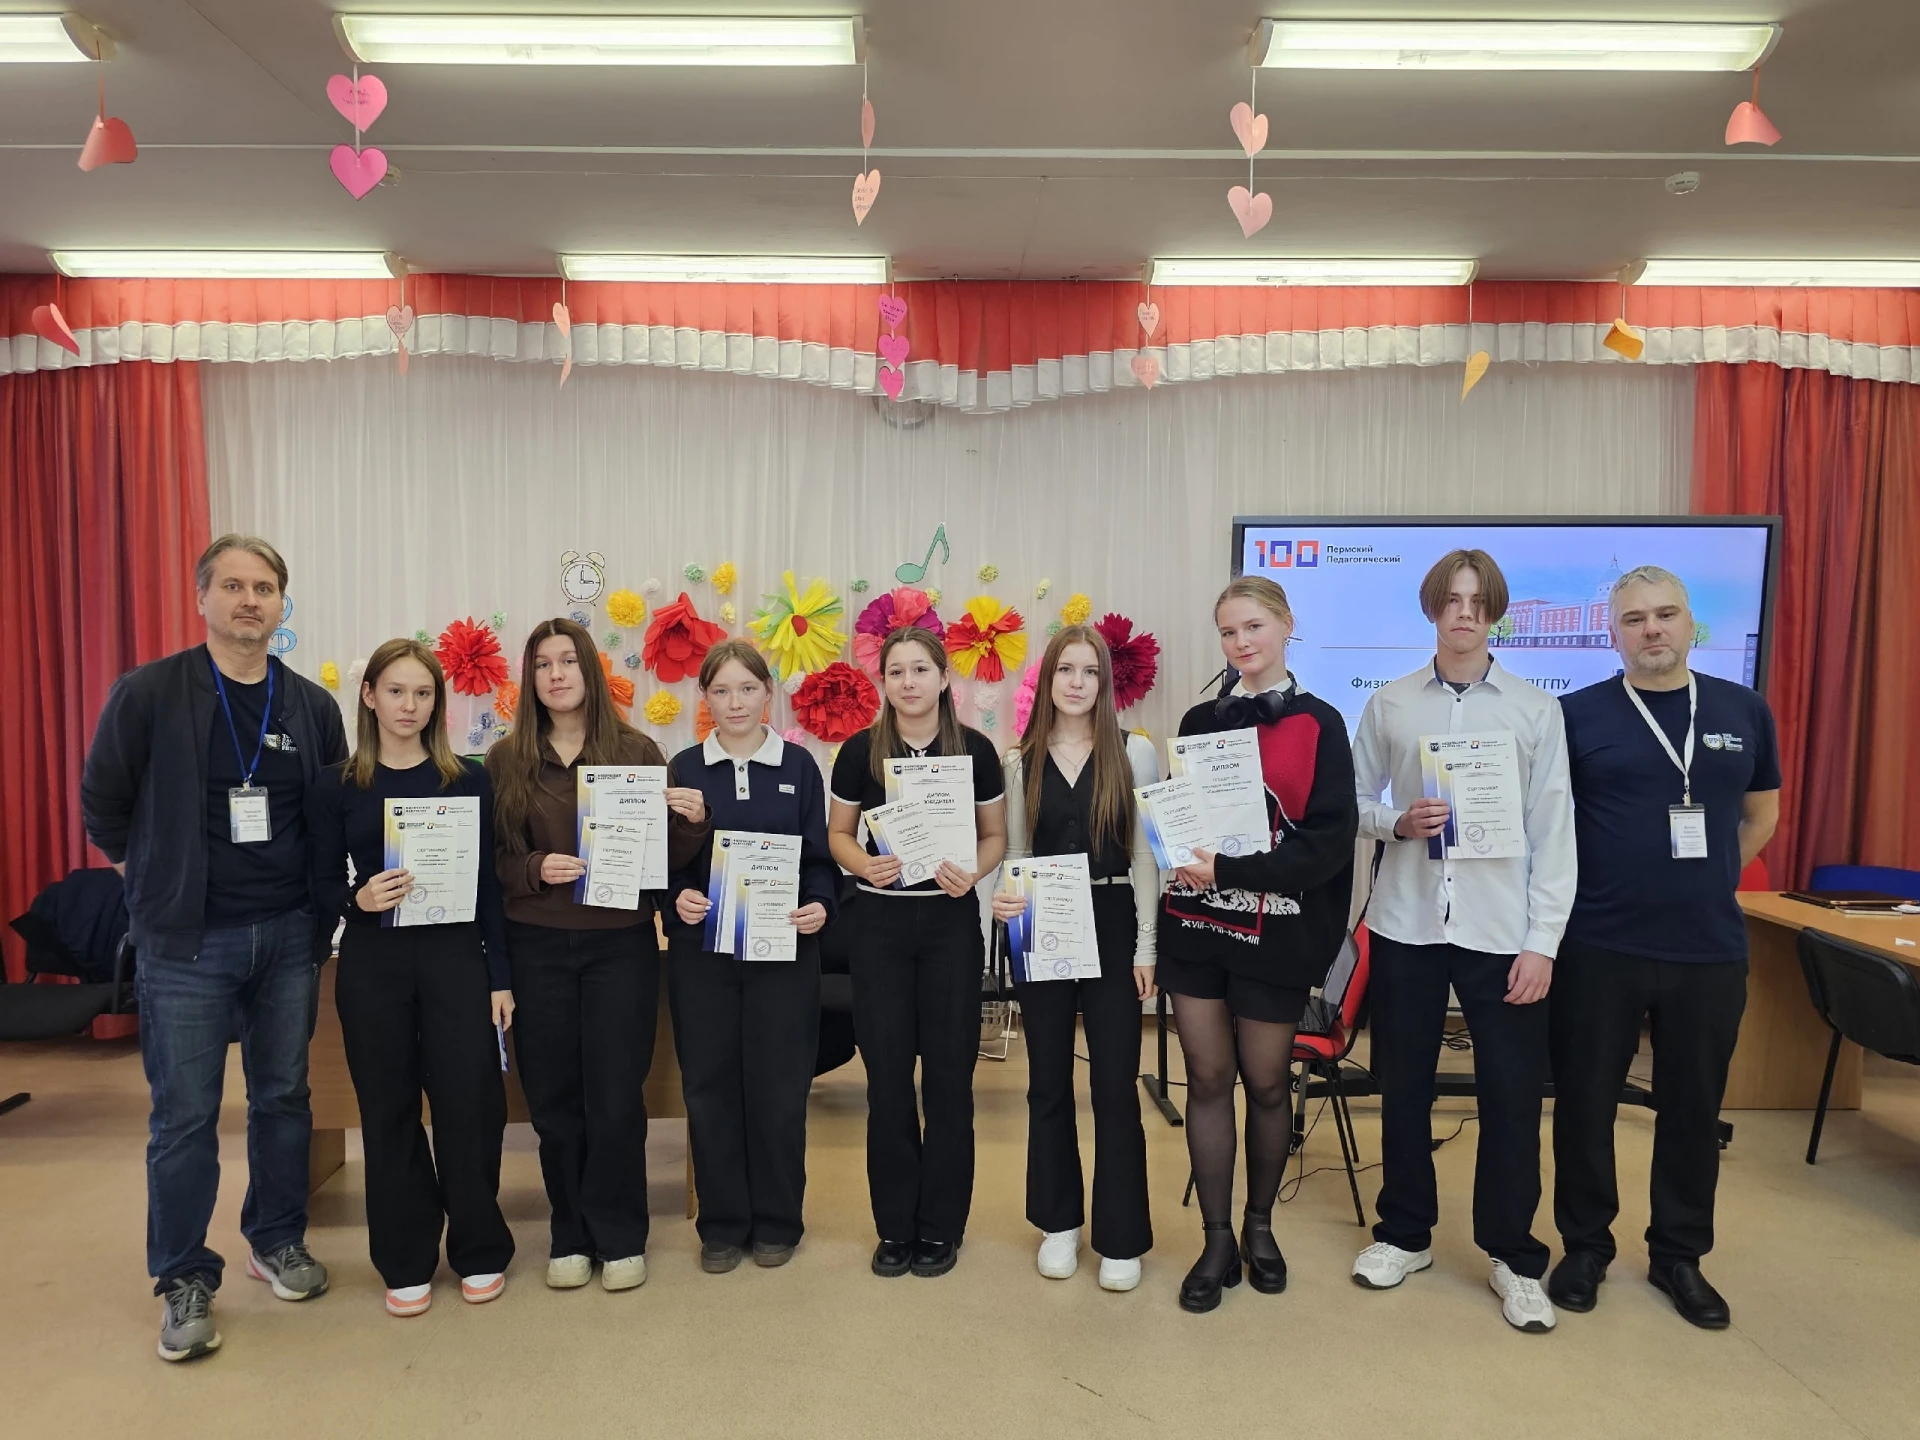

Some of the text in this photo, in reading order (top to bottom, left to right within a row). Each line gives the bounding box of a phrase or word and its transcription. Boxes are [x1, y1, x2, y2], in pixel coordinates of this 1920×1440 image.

[1255, 540, 1319, 567] 100
[1326, 545, 1373, 553] Пермский
[1326, 555, 1401, 564] Педагогический
[1351, 676, 1392, 689] Физи
